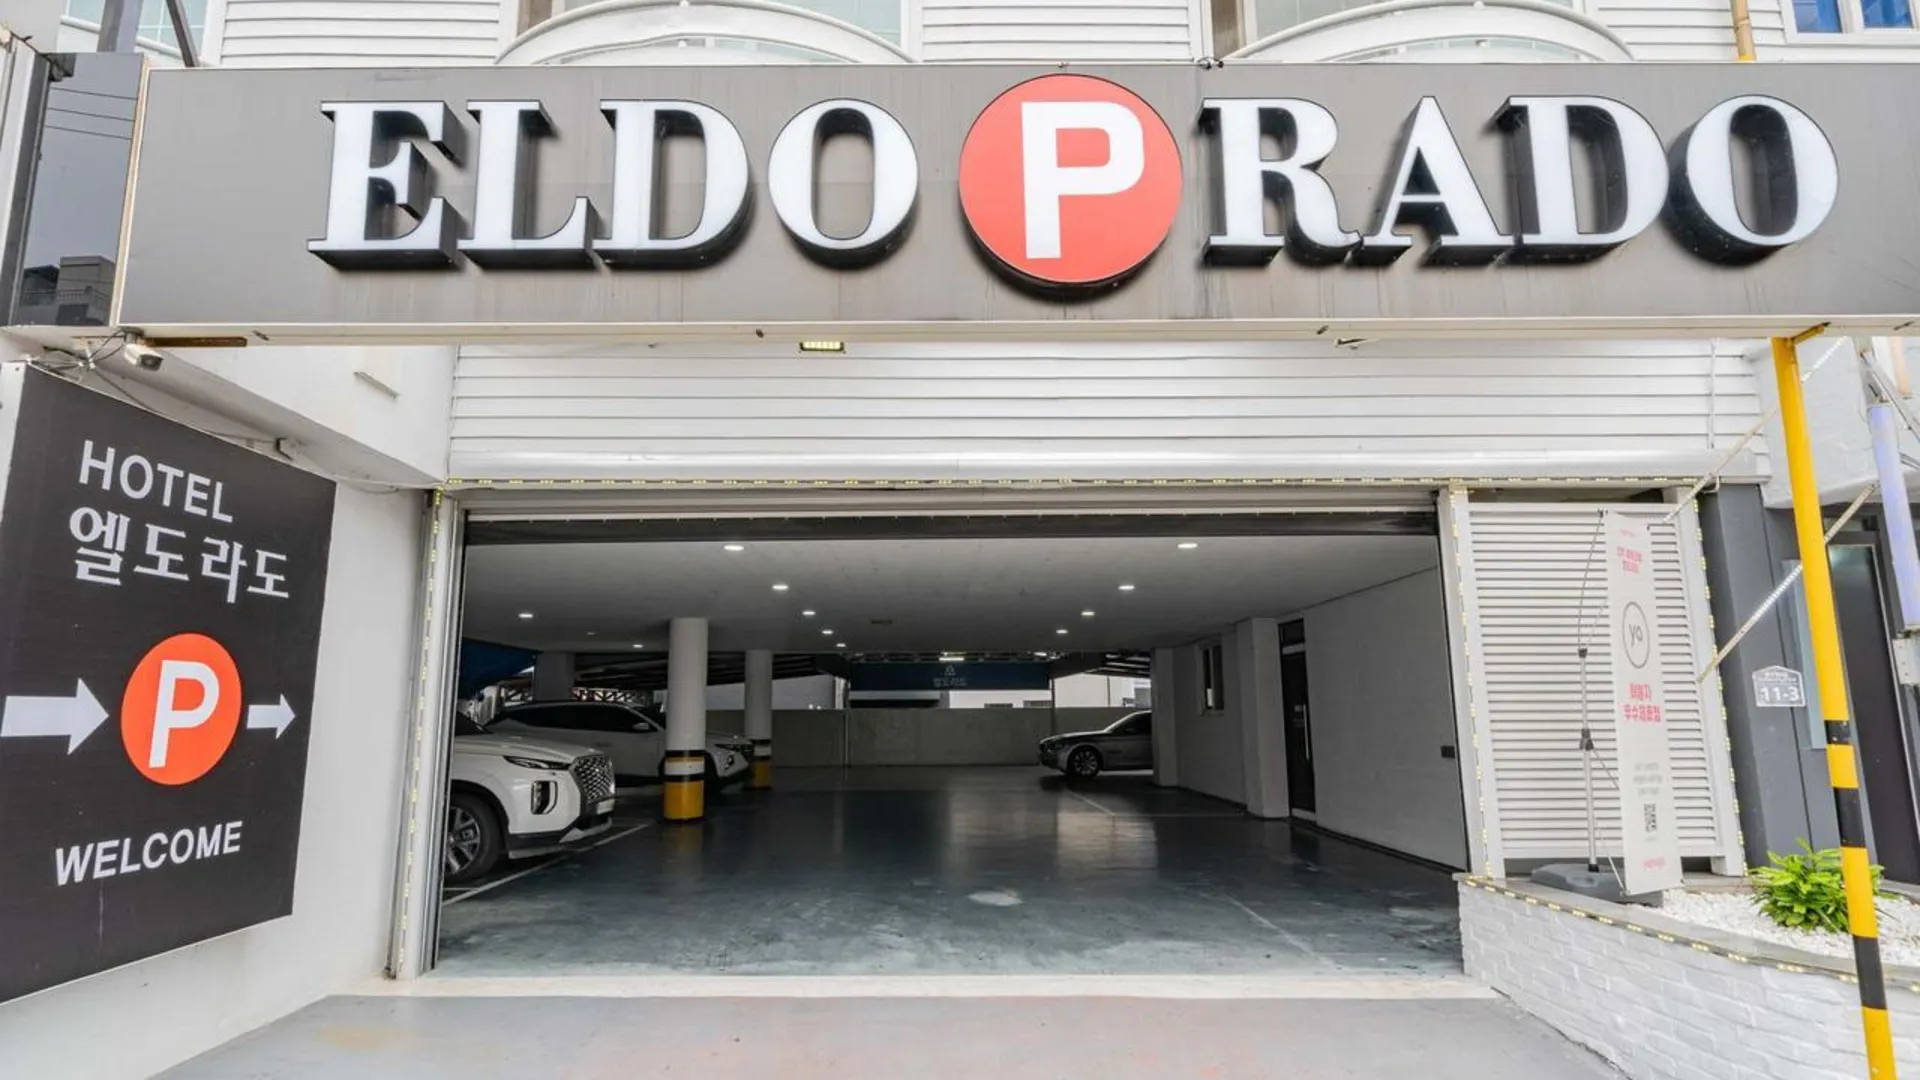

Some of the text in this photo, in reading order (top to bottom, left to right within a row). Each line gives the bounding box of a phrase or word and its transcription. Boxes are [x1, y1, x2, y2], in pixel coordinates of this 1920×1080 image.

[306, 94, 1839, 259] ELDO P RADO
[79, 440, 234, 523] HOTEL
[69, 506, 291, 603] 엘도라도
[149, 660, 220, 768] P
[1759, 686, 1800, 702] 11-3
[55, 821, 243, 886] WELCOME
